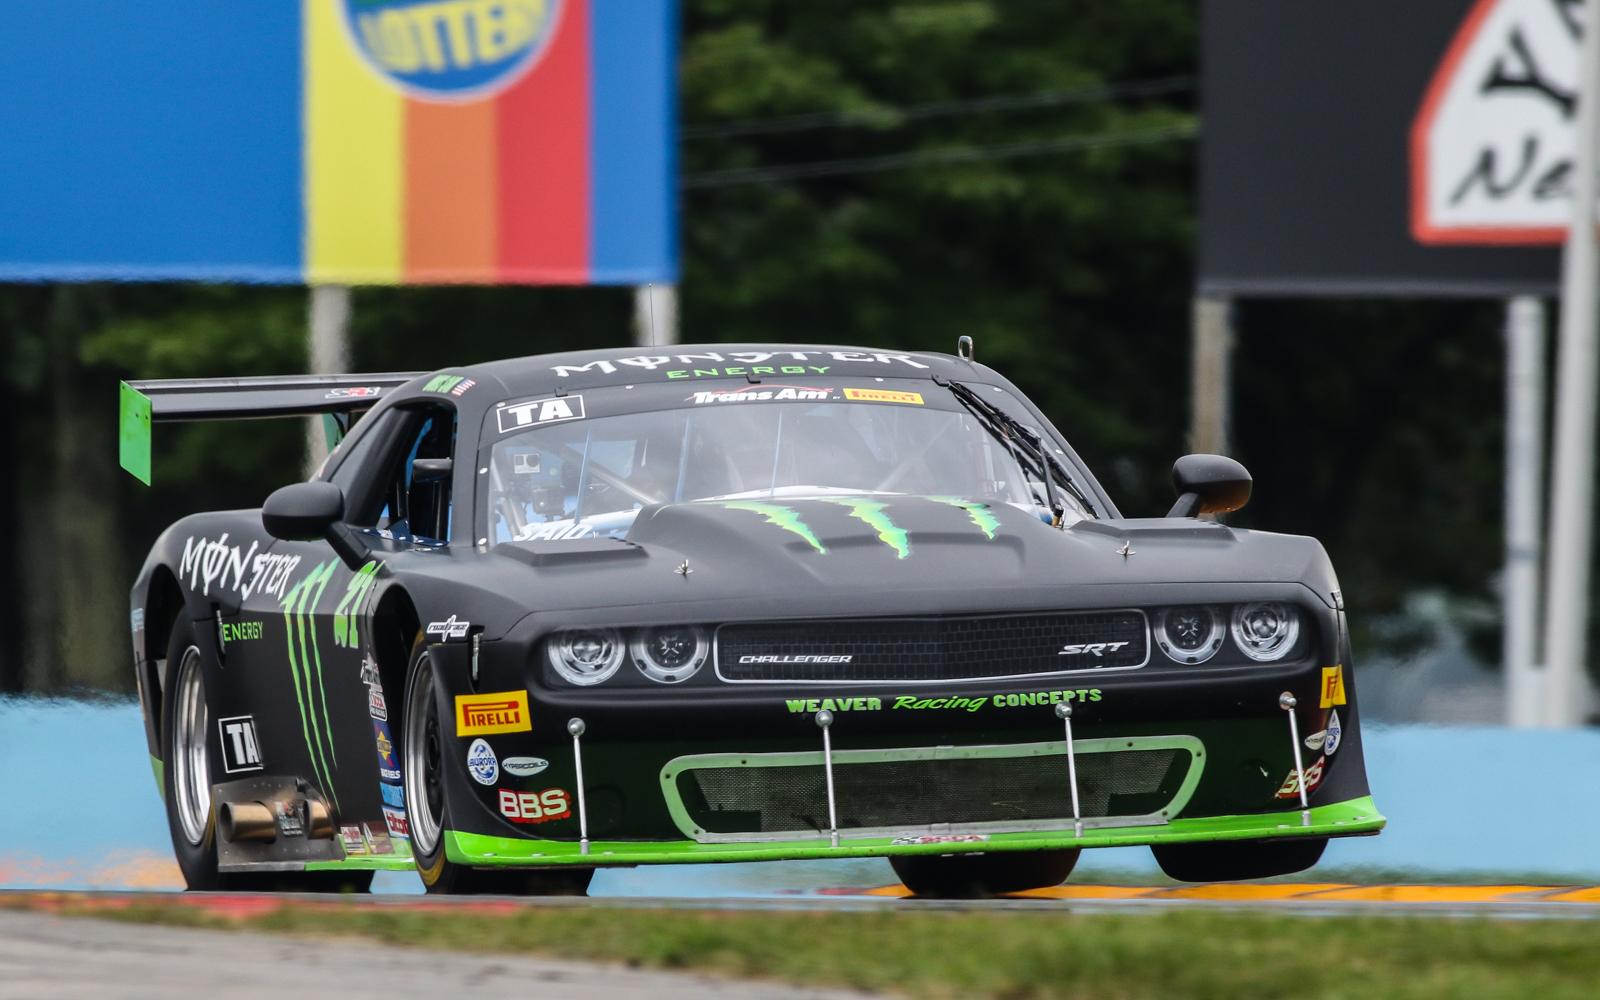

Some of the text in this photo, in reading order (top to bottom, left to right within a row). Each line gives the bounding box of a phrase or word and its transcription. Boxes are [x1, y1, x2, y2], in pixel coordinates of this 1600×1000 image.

[665, 365, 831, 379] ENERGY
[692, 387, 828, 404] Trans Am
[507, 399, 574, 426] TA
[222, 621, 263, 642] ENERGY
[738, 655, 853, 665] CHALLENGER
[1058, 641, 1130, 657] SRT
[786, 688, 1102, 714] WEAVER Racing CONCEPTS
[462, 700, 521, 727] PIRELLI
[226, 722, 260, 765] TA
[500, 789, 568, 819] BBS
